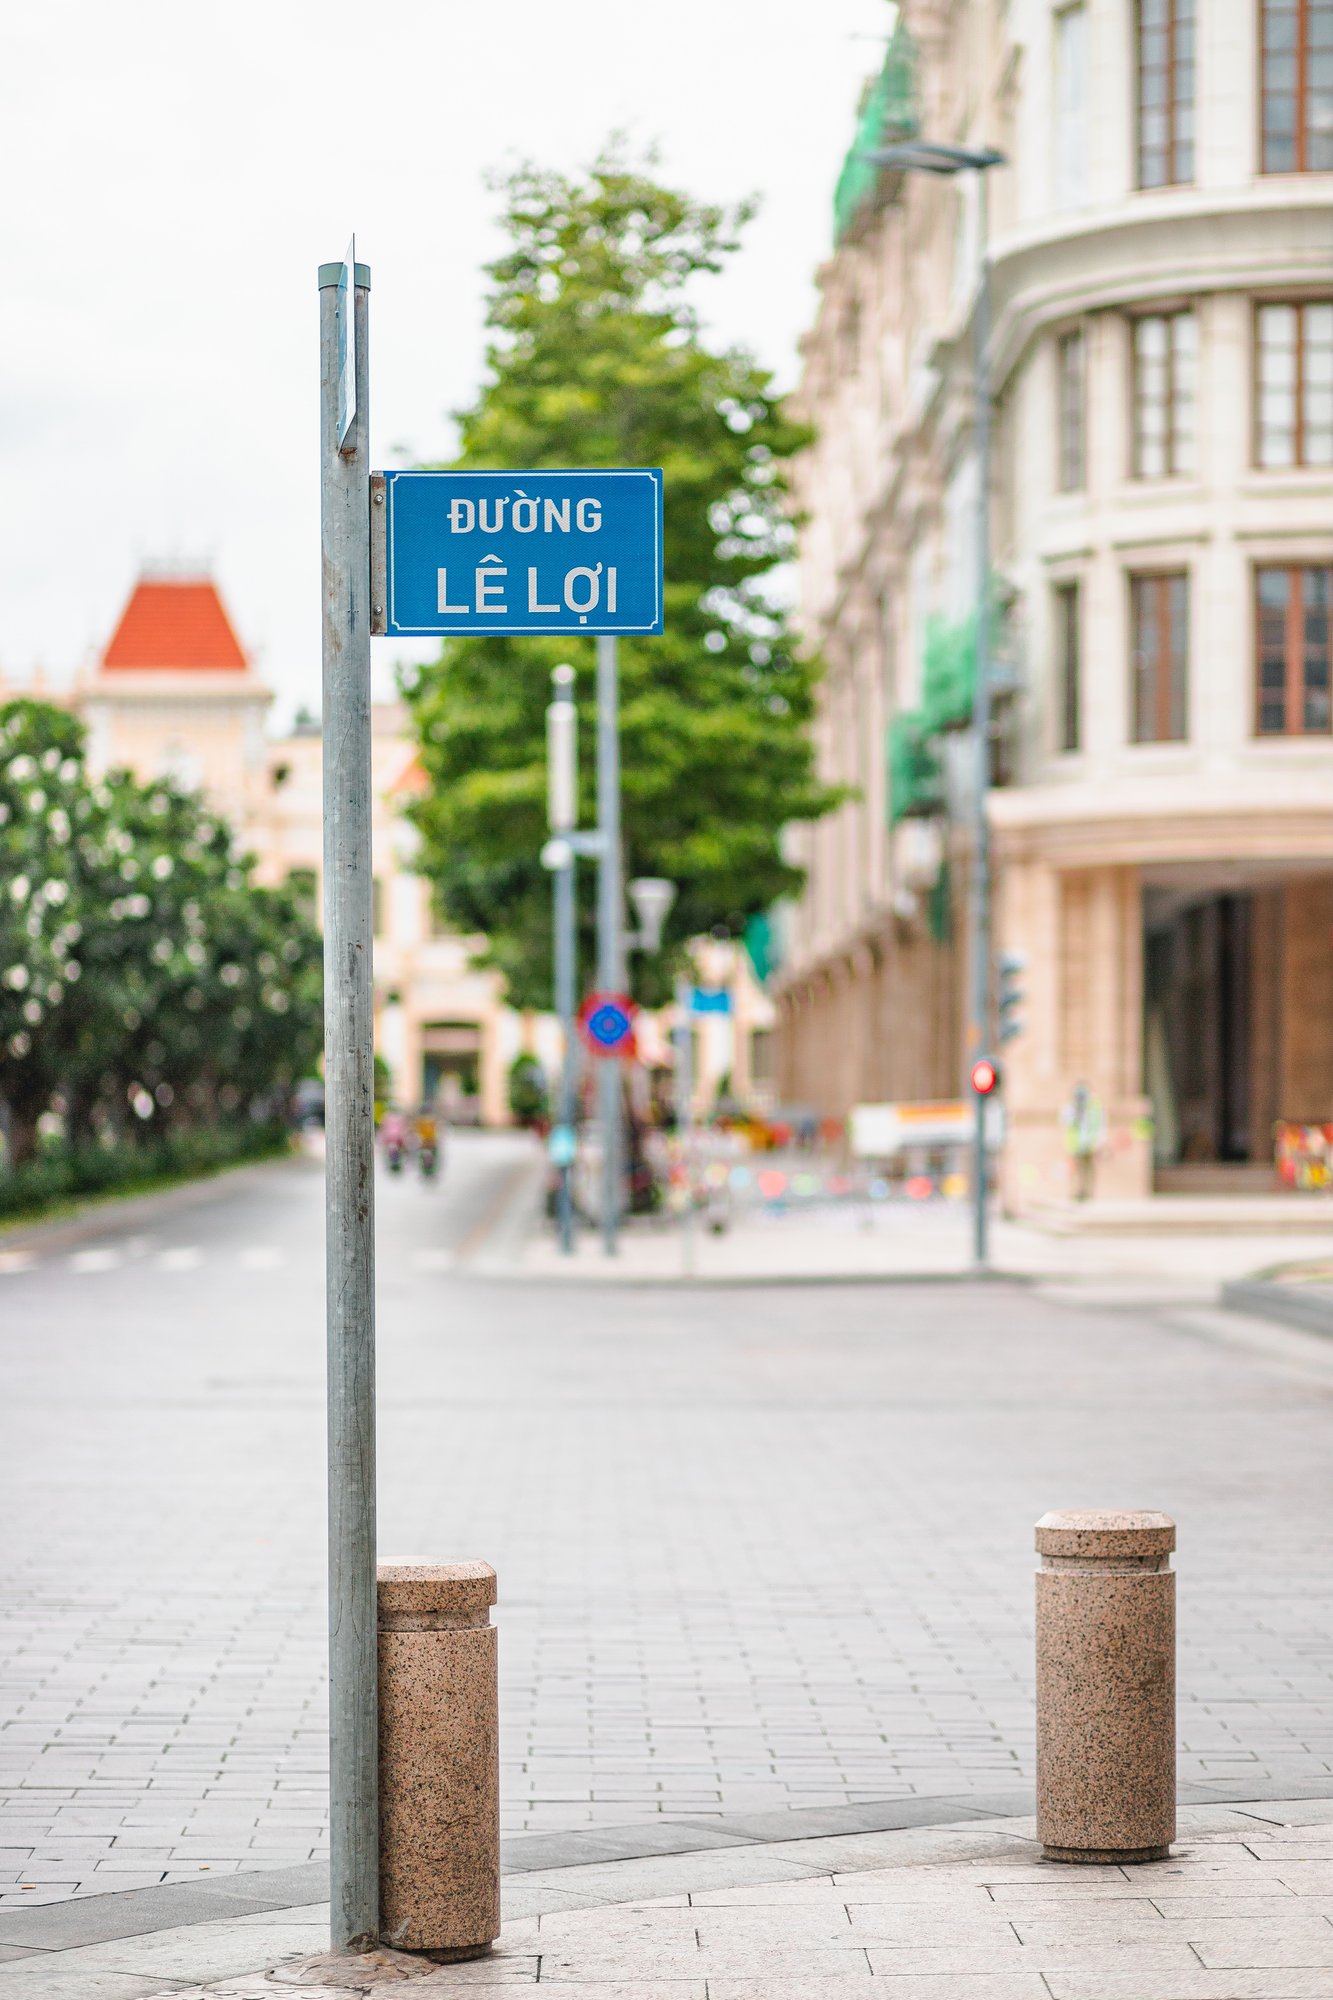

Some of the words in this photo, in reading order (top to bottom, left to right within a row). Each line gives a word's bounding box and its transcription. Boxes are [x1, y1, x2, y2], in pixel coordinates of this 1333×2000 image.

[446, 489, 603, 534] ĐƯỜNG
[437, 553, 508, 614] LÊ
[528, 561, 617, 624] LỢI
